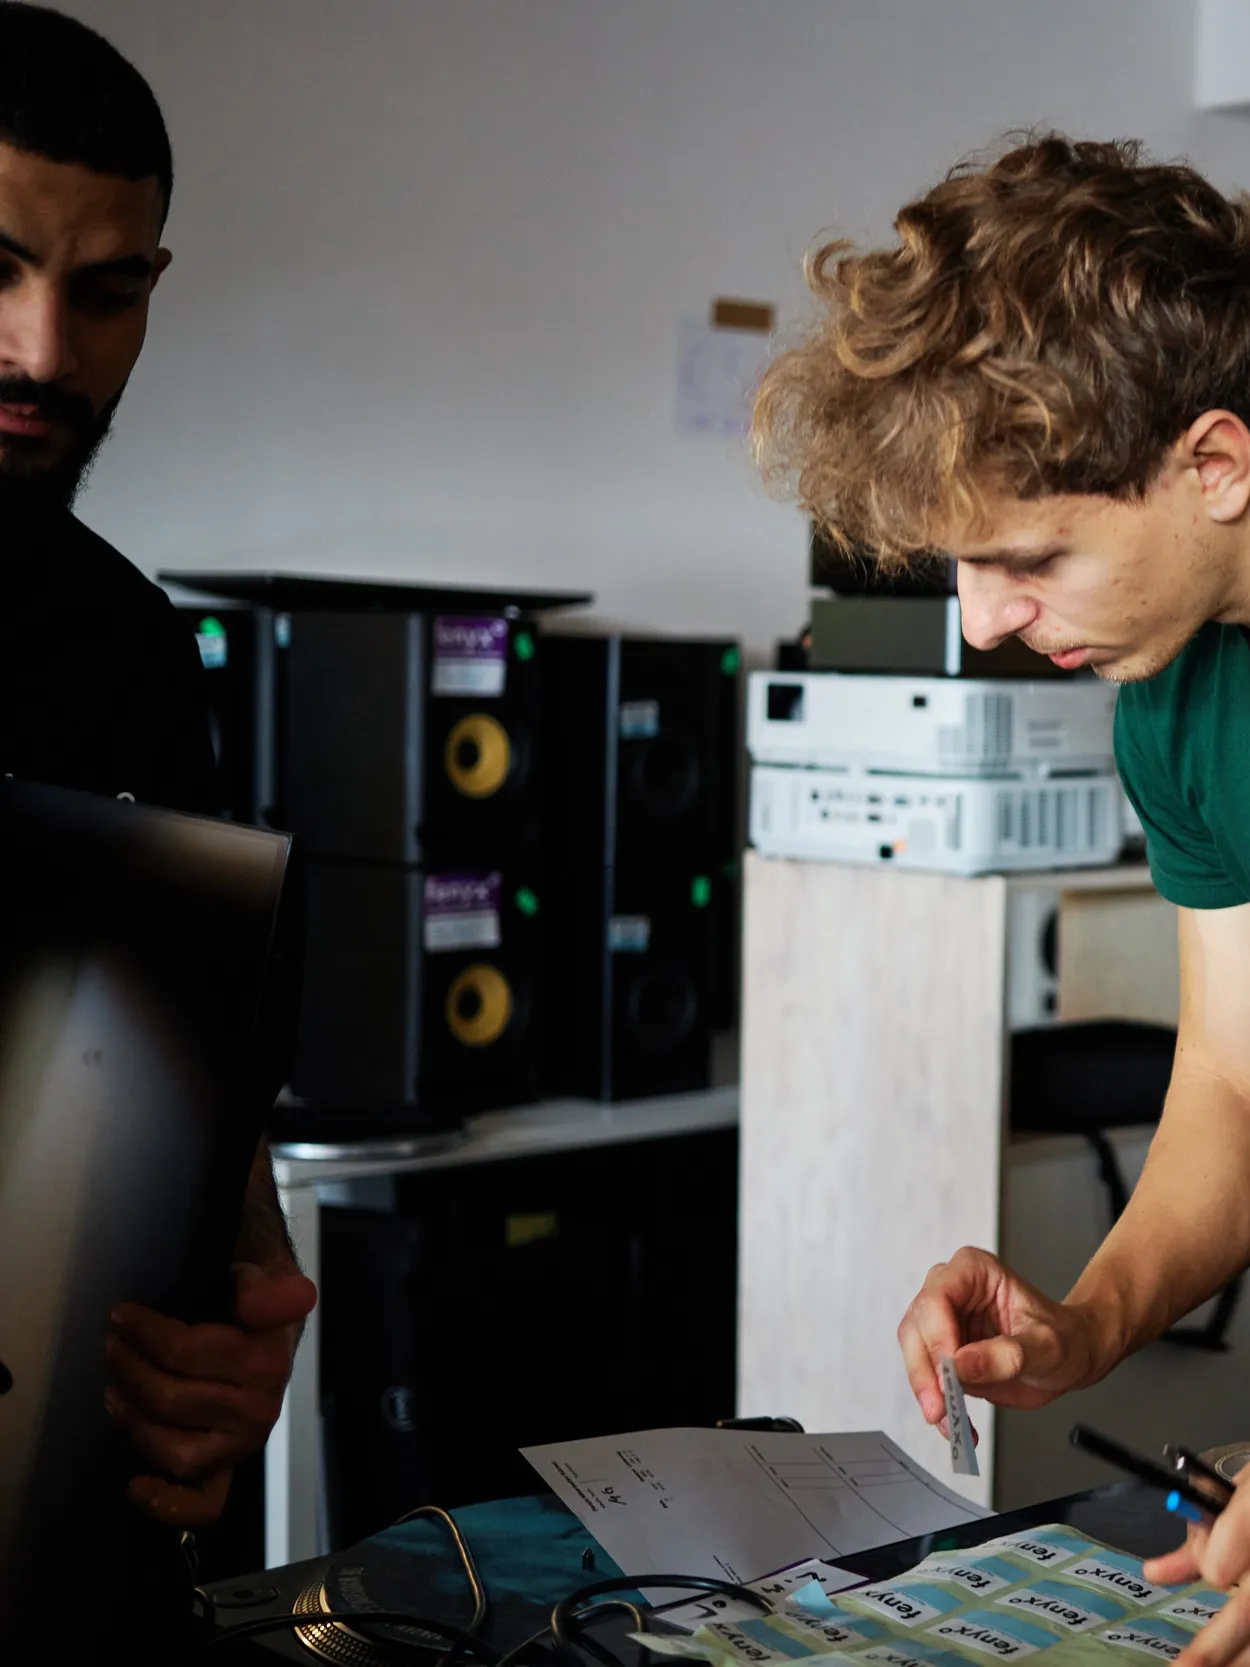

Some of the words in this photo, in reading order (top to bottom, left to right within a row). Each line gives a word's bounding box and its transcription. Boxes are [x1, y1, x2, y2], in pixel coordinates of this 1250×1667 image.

[1074, 1567, 1152, 1598] fenyx°
[1009, 1595, 1089, 1625] fenyx°
[938, 1625, 1020, 1655] fenyx°
